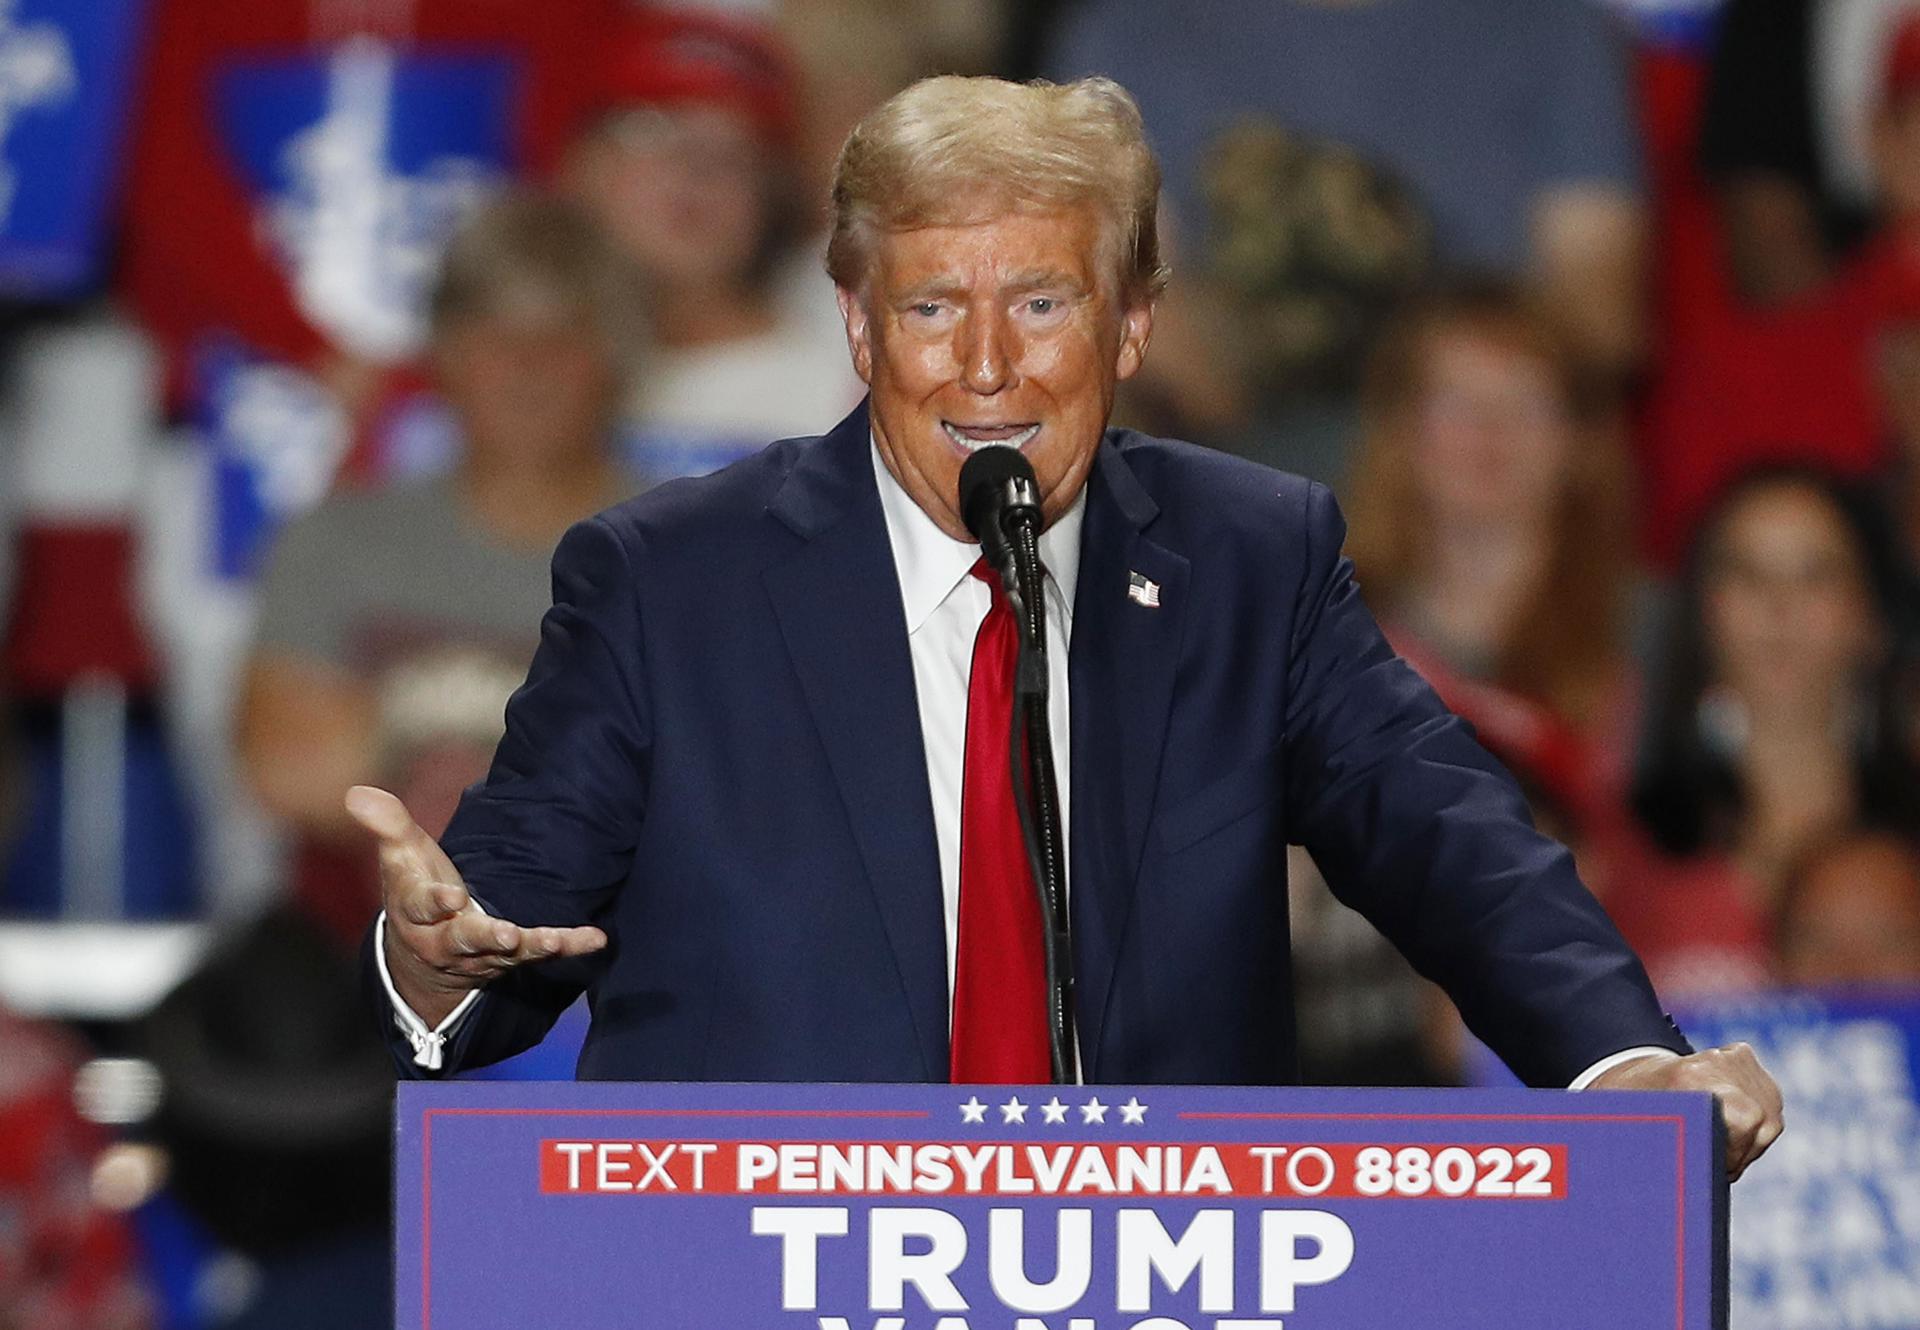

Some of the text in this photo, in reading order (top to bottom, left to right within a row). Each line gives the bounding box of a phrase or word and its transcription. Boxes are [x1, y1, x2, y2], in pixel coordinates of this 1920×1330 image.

[555, 1143, 1552, 1196] TEXT PENNSYLVANIA TO 88022
[751, 1206, 1355, 1314] TRUMP
